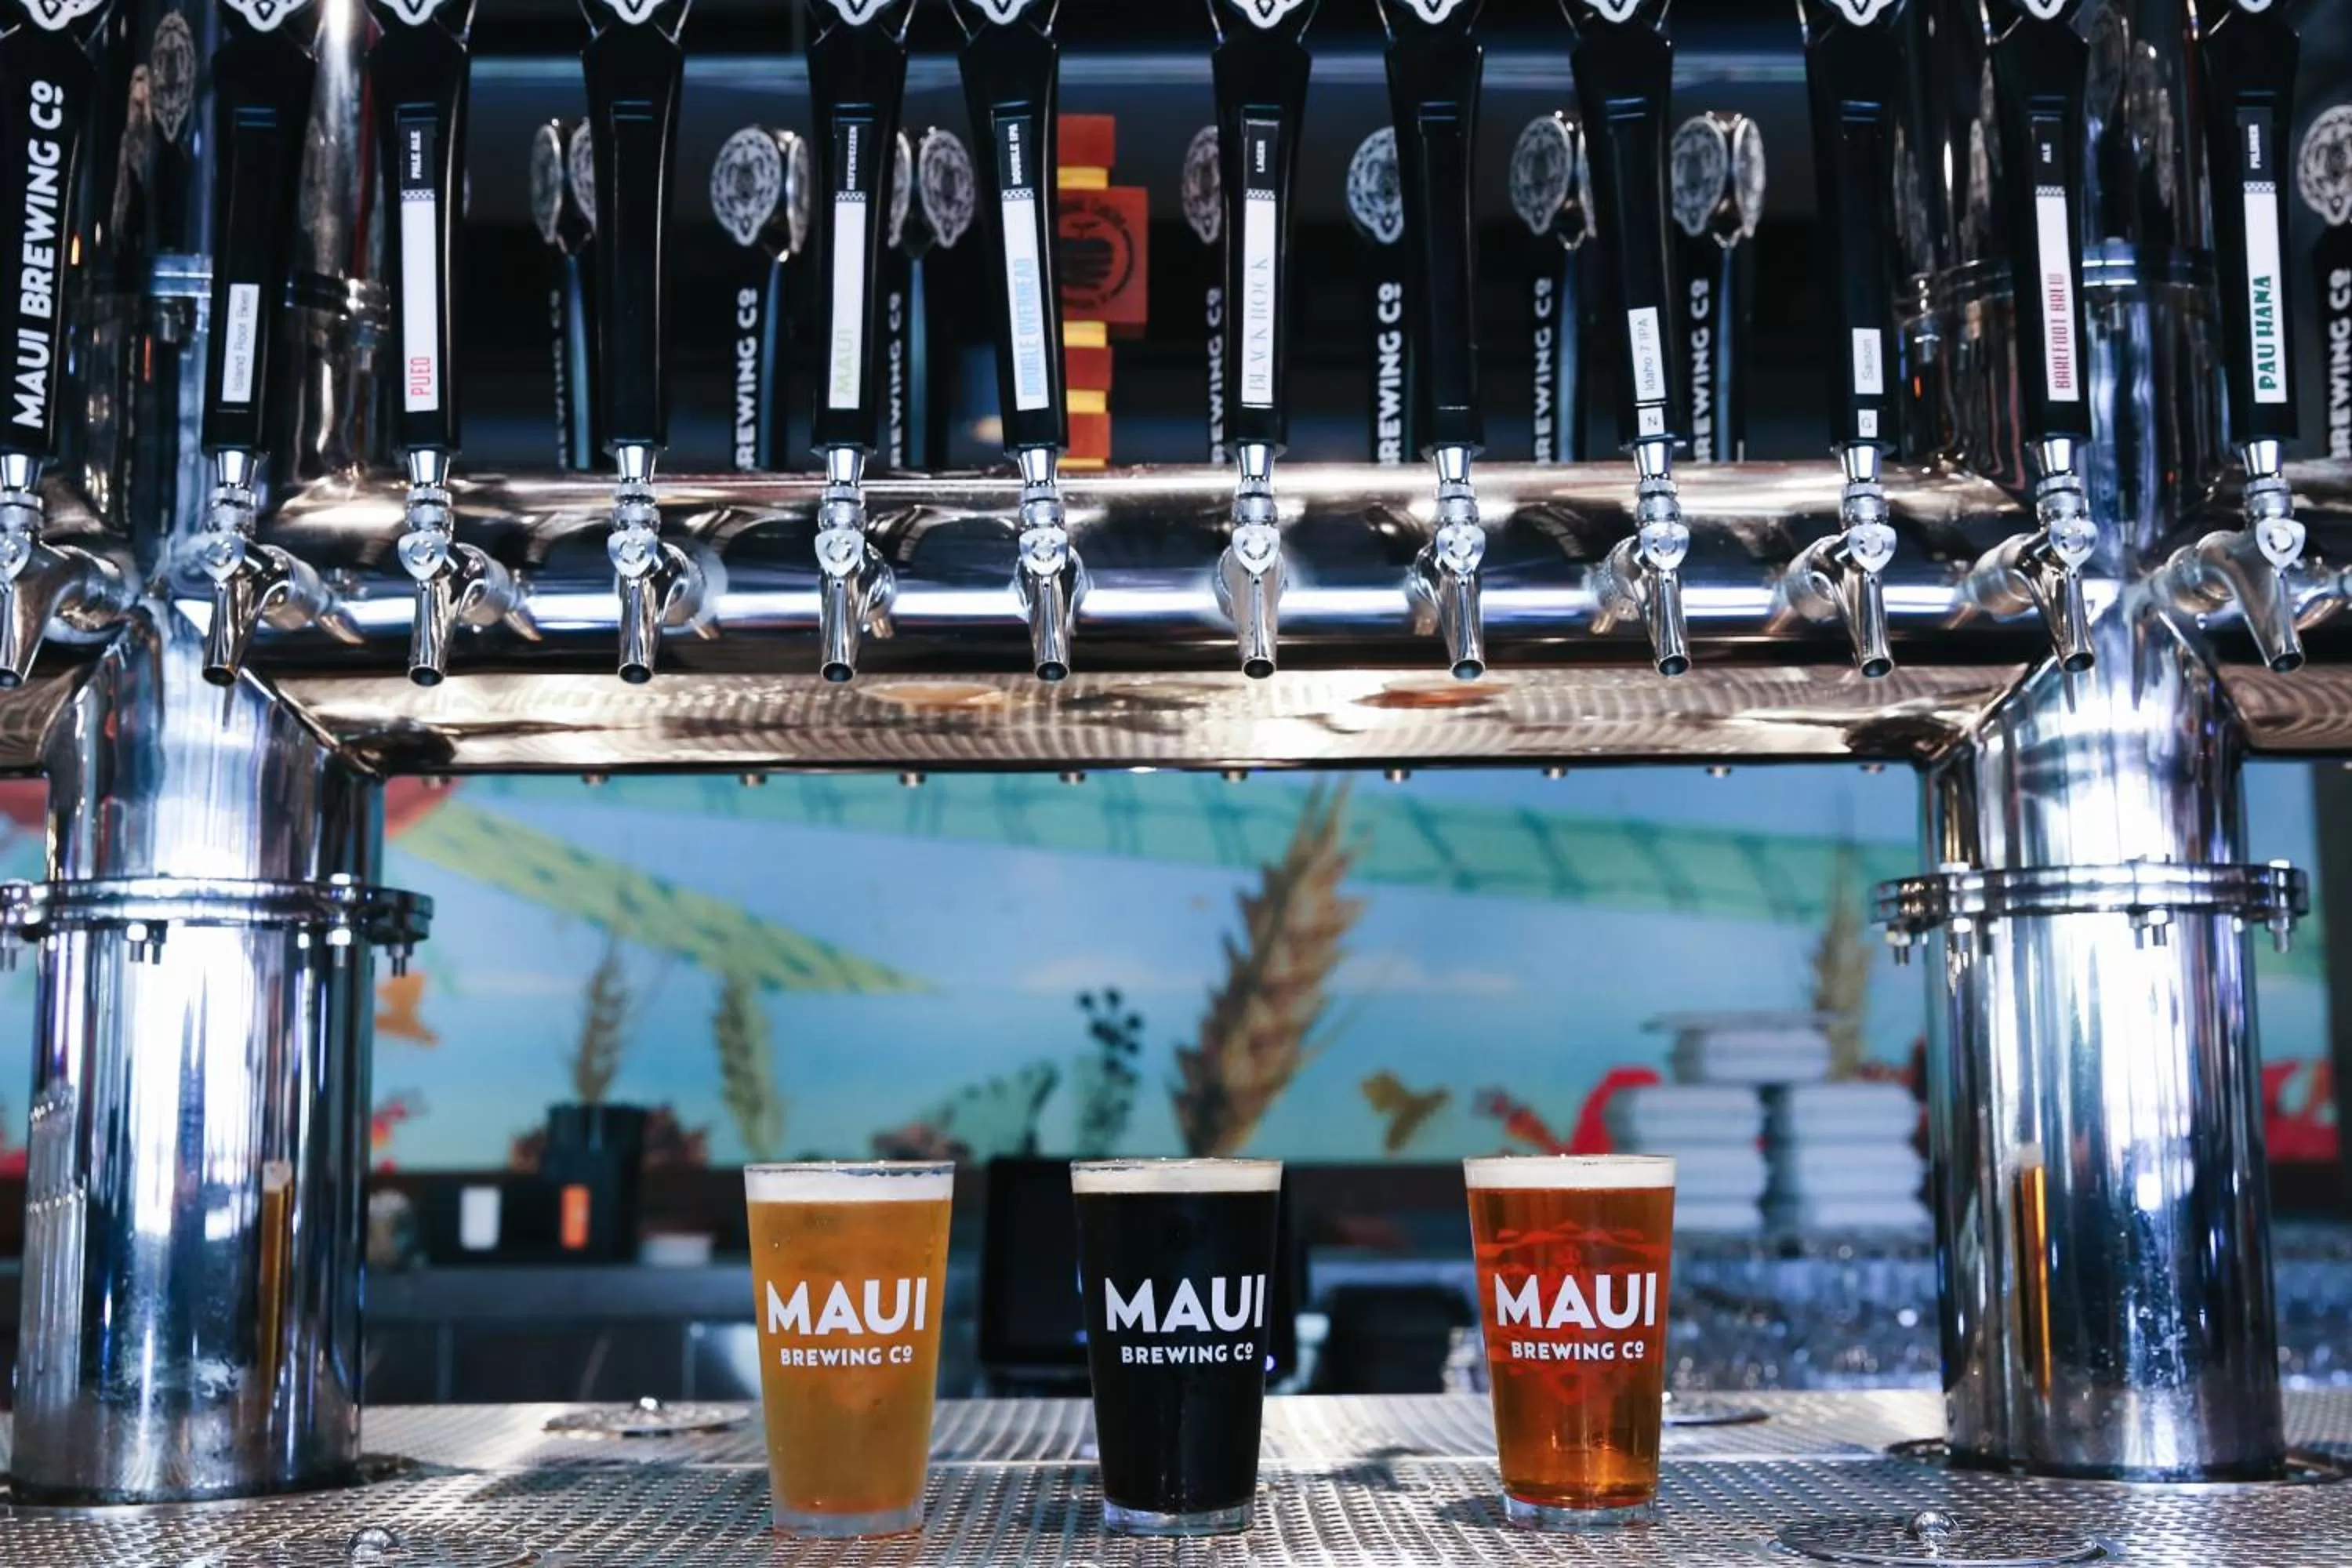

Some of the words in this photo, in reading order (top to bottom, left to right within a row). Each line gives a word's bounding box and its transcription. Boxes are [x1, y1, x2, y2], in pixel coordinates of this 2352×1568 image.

[410, 129, 422, 151] ALE
[1007, 122, 1020, 142] IPA
[2041, 143, 2052, 164] ALE
[2248, 123, 2262, 169] PILSNER
[410, 151, 423, 180] PALE
[1008, 143, 1022, 186] DOUBLE
[1256, 140, 1266, 173] LAGER
[20, 137, 61, 319] BREWING
[1013, 257, 1038, 336] OVERHEAD
[2047, 273, 2067, 312] BREW
[2252, 275, 2275, 338] HANA
[1637, 318, 1651, 343] IPA
[2050, 319, 2071, 389] BAREFOOT
[12, 327, 51, 429] MAUI
[410, 356, 431, 396] PUEO
[836, 329, 854, 397] MAUI
[1020, 339, 1043, 397] DOUBLE
[1248, 328, 1268, 390] BLACK
[1642, 357, 1656, 391] Idaho
[2257, 343, 2278, 390] PAU
[735, 336, 758, 470] REWING
[890, 338, 902, 469] REWING
[1207, 334, 1225, 466] REWING
[765, 1276, 928, 1336] MAUI
[1104, 1273, 1266, 1333] MAUI
[1494, 1272, 1657, 1330] MAUI
[779, 1346, 883, 1367] BREWING
[1120, 1345, 1228, 1365] BREWING
[1511, 1341, 1615, 1360] BREWING
